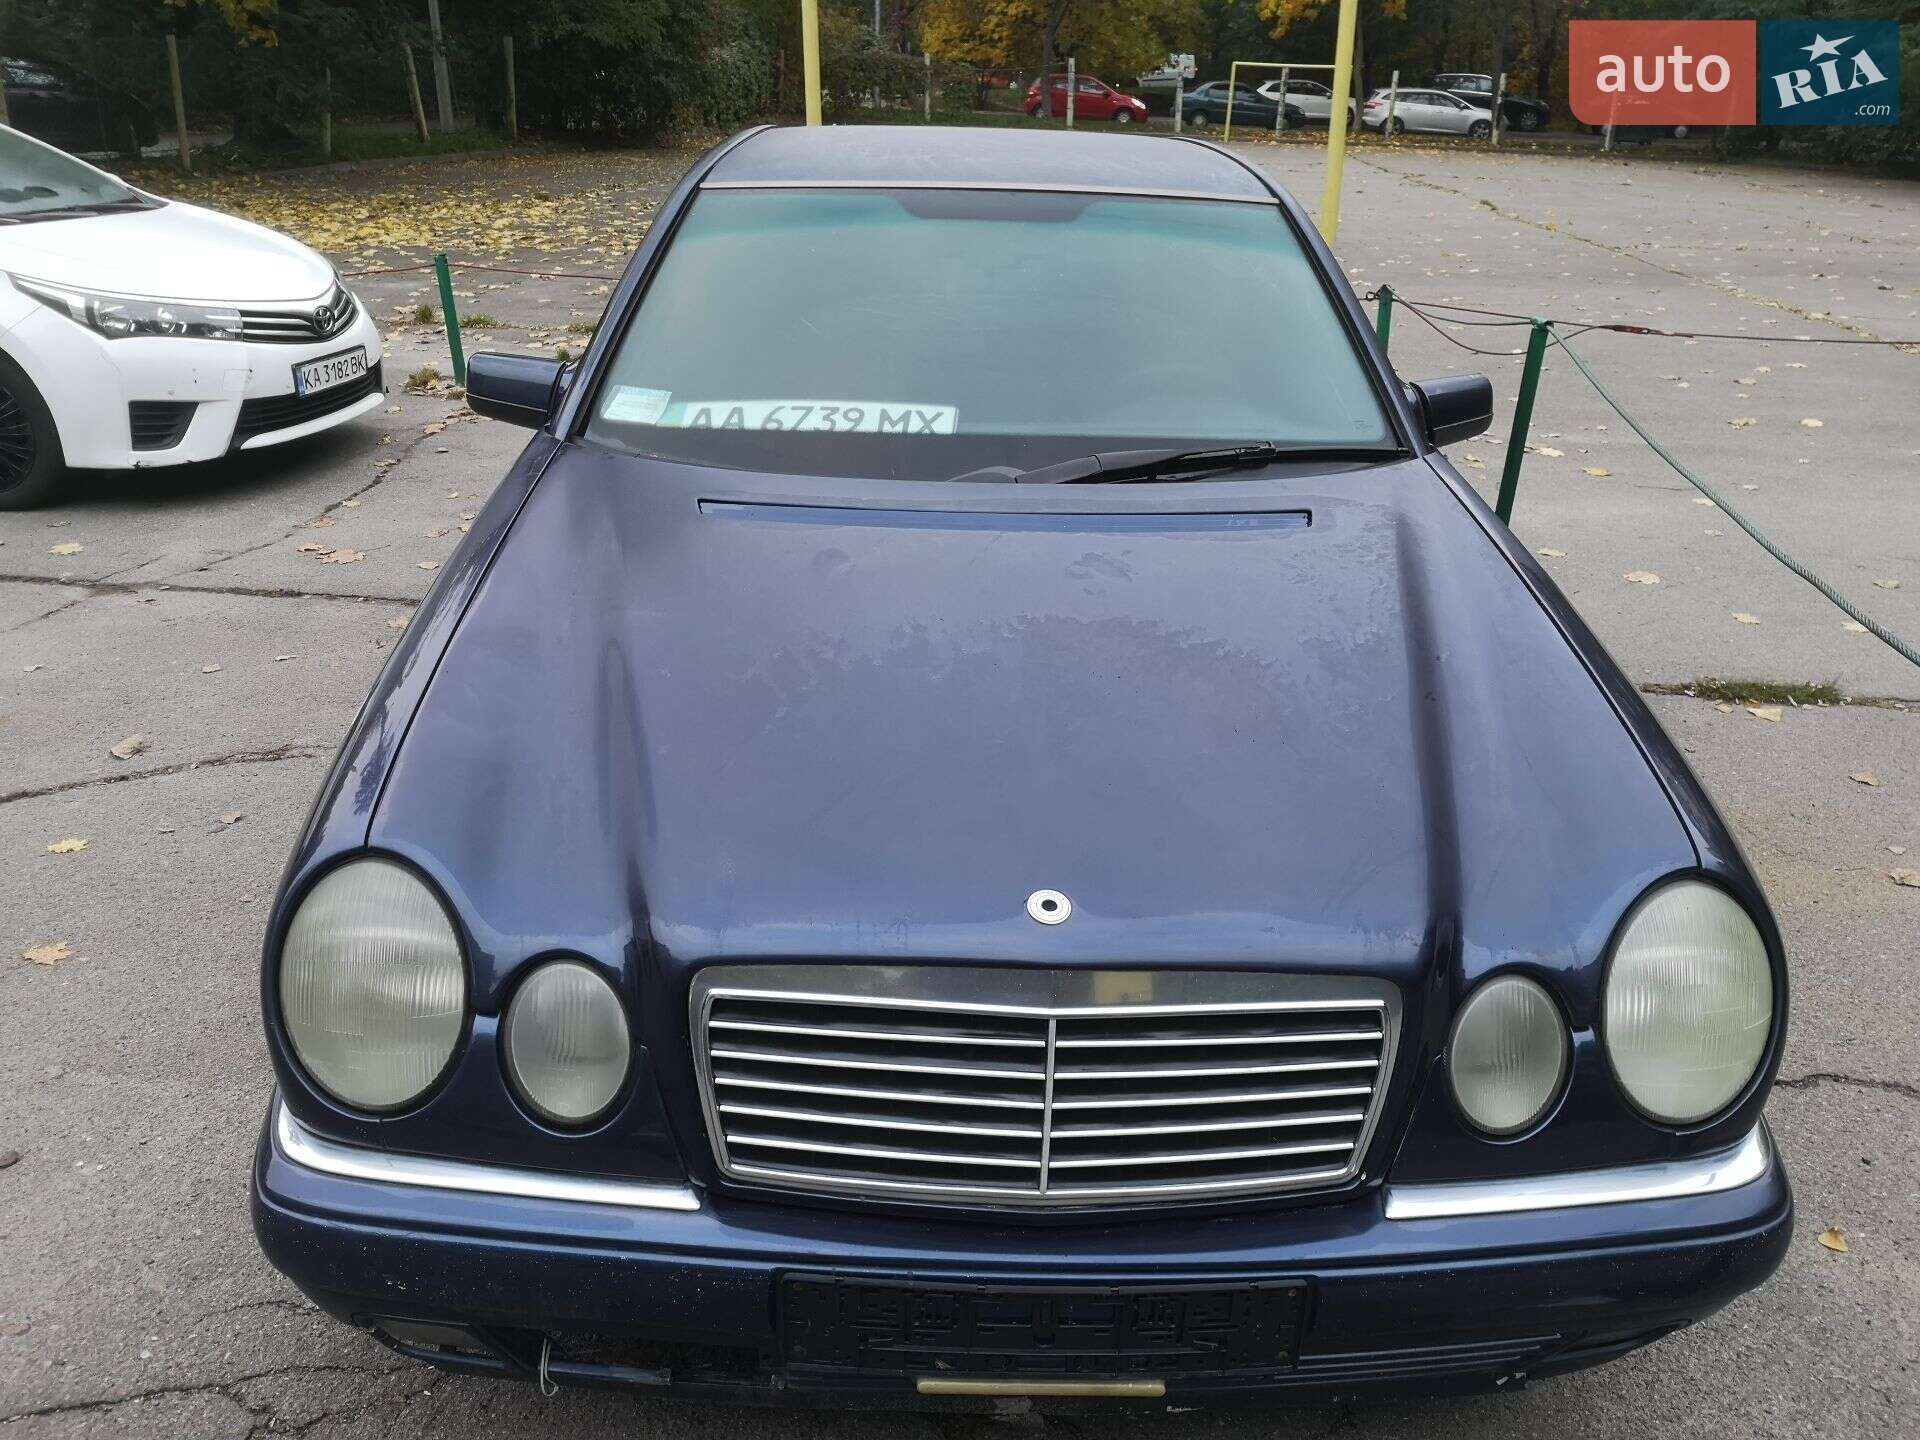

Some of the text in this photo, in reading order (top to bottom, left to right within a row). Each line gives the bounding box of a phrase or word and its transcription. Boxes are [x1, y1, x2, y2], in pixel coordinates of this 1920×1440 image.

[303, 354, 366, 389] KA 3182 BK
[689, 405, 945, 434] AA 6739 MX
